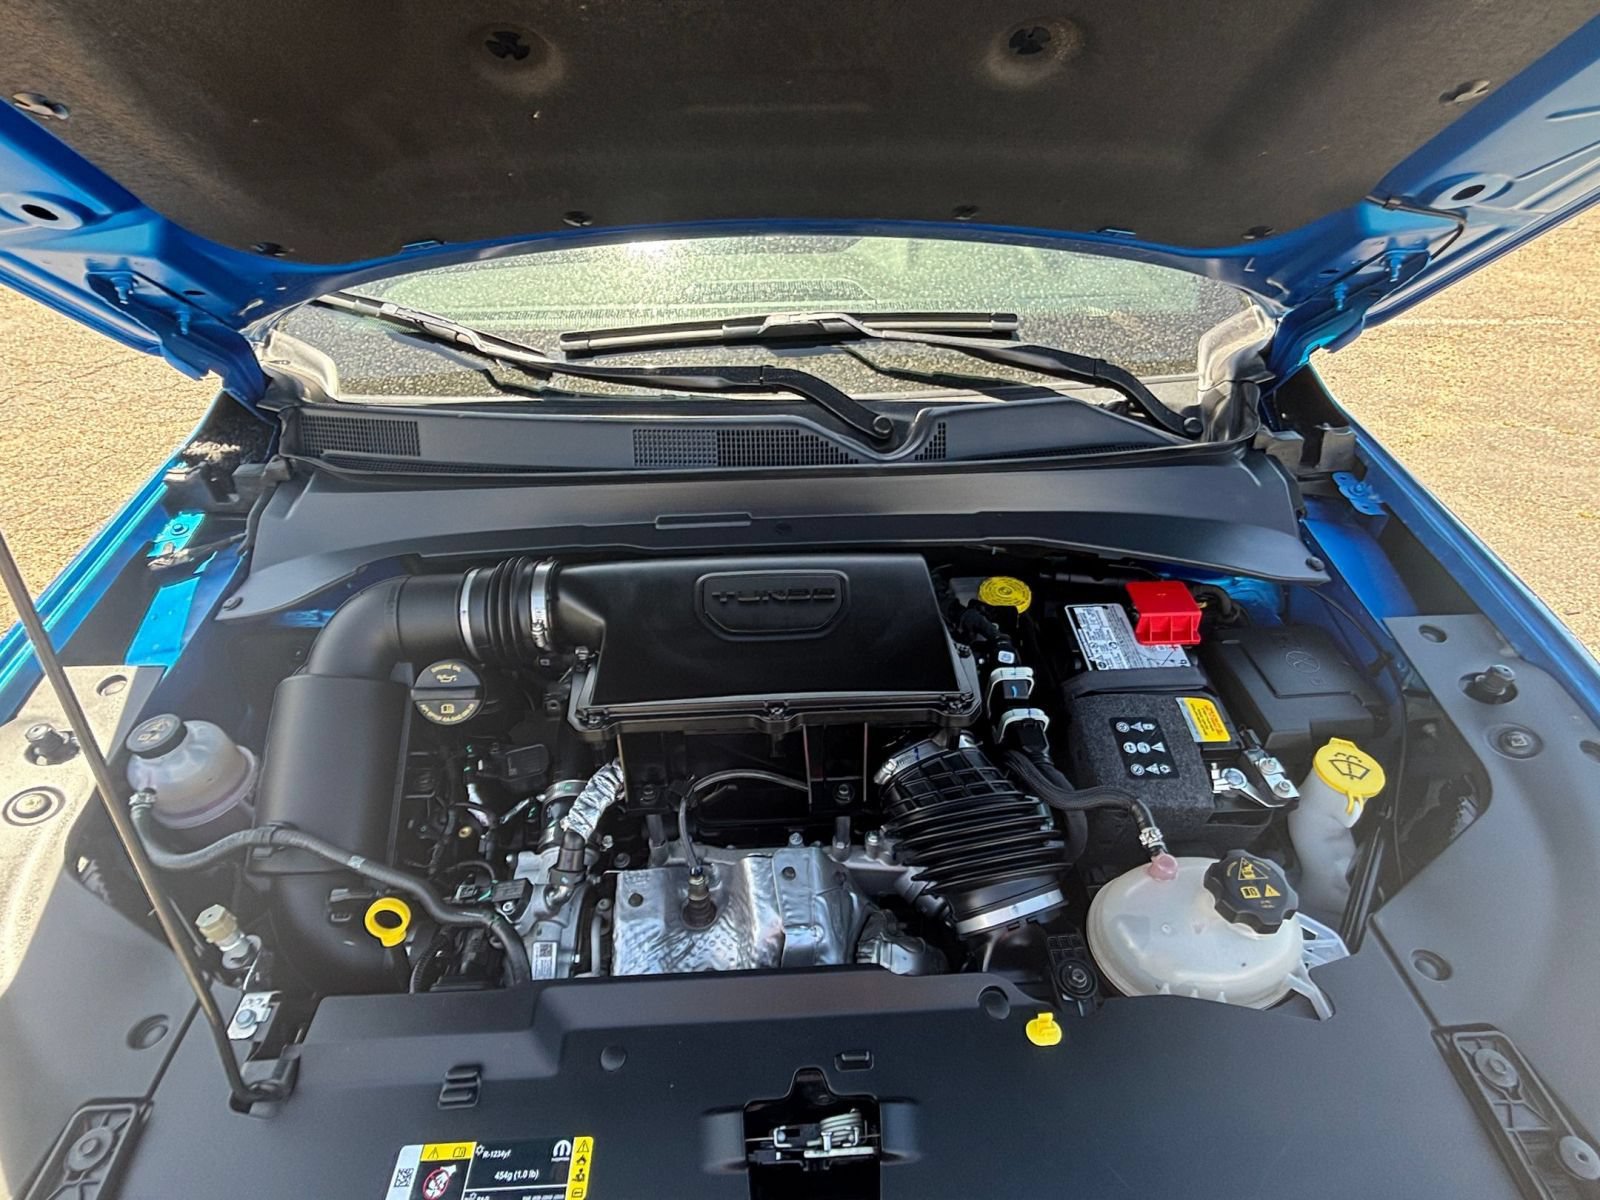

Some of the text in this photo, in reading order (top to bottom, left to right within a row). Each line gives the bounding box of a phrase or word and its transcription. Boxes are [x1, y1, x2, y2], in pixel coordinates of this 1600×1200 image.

[494, 1169, 539, 1181] 454g (1.0 lb)
